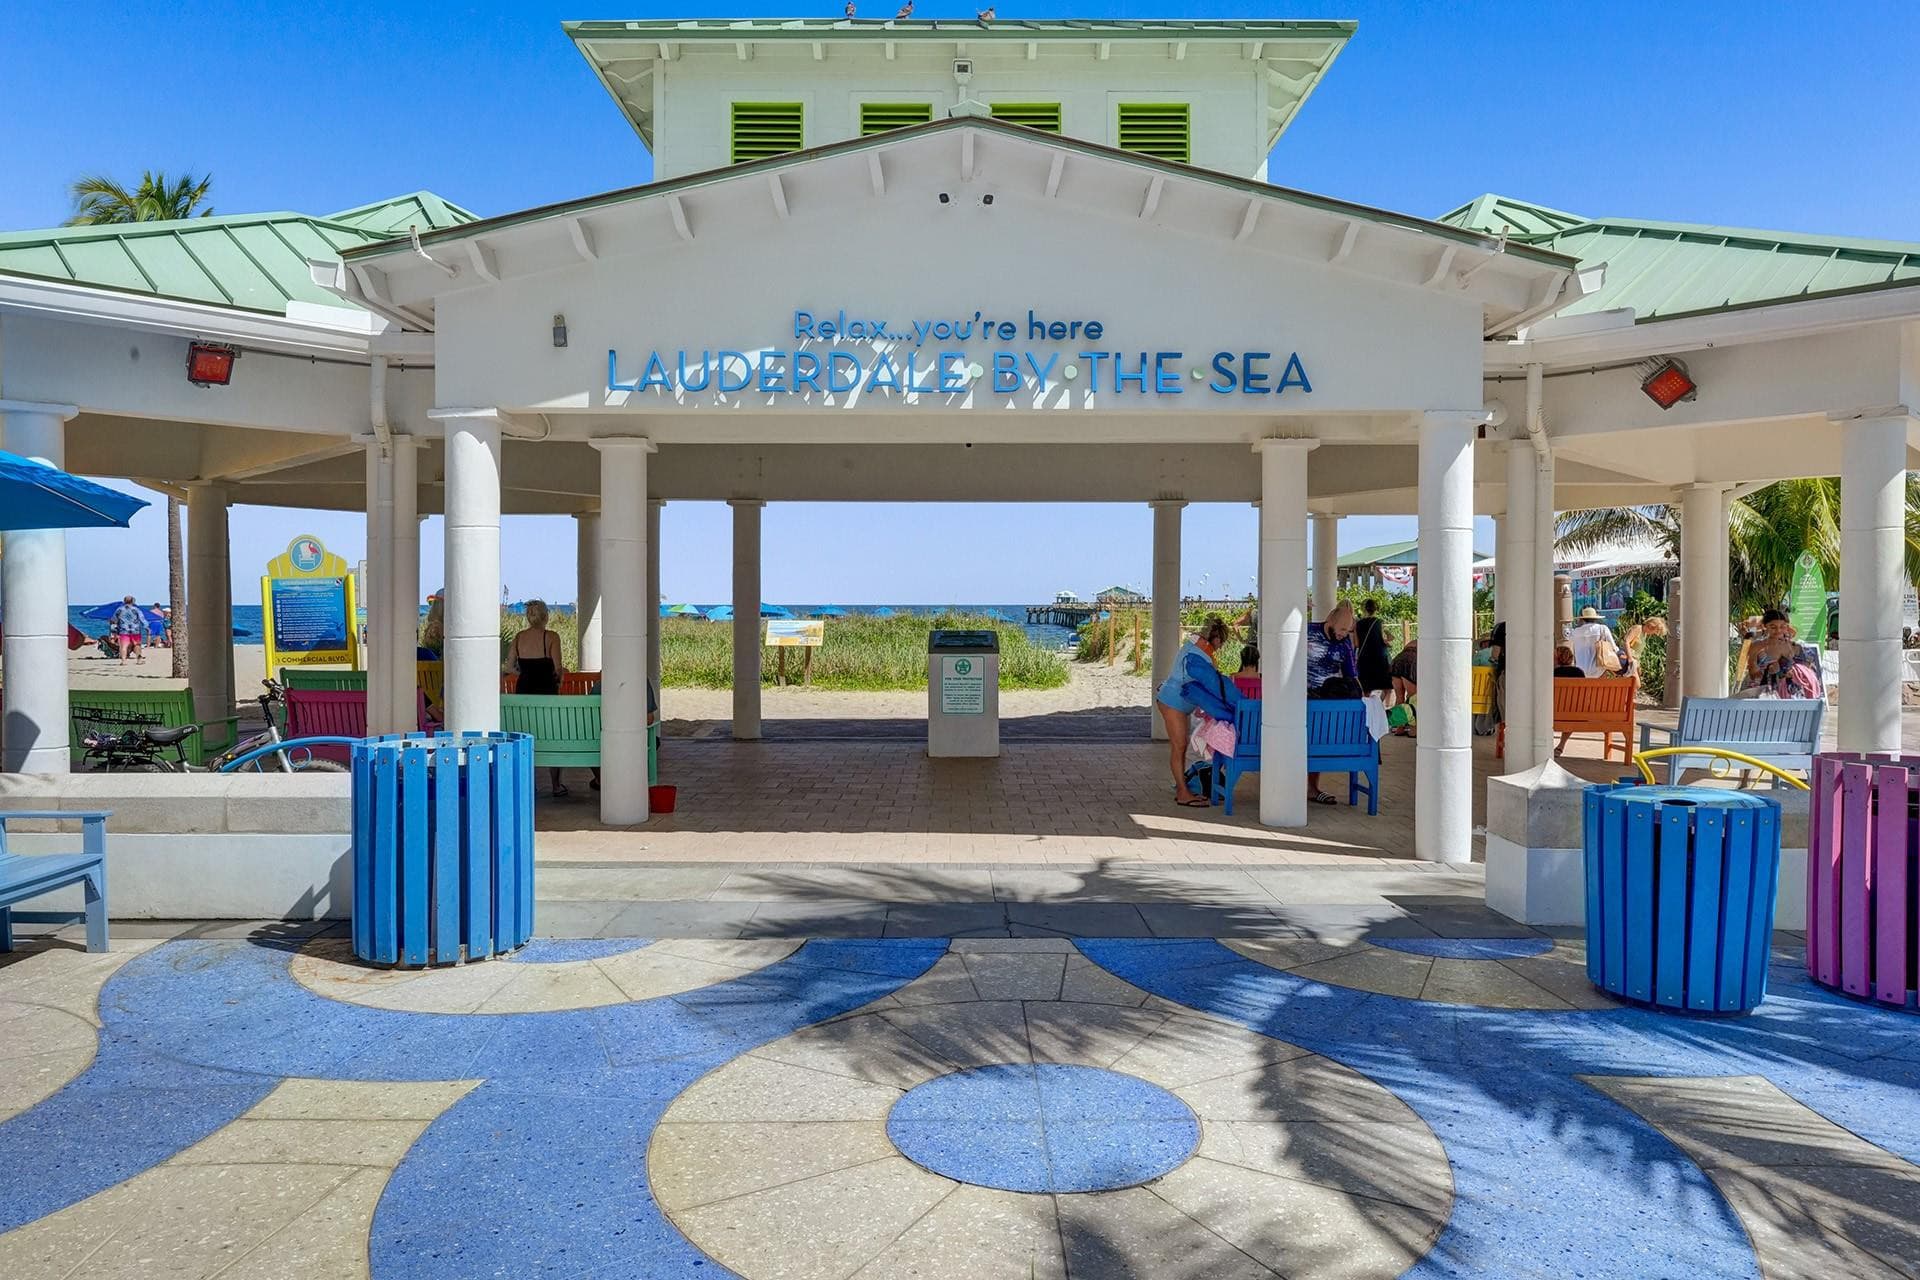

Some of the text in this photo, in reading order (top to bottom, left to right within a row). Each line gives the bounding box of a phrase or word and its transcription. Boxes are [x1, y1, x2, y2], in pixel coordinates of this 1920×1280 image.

[1028, 310, 1104, 341] here
[607, 350, 1313, 394] LAUDERDALE BY THE SEA
[281, 656, 327, 664] COMMERCIAL
